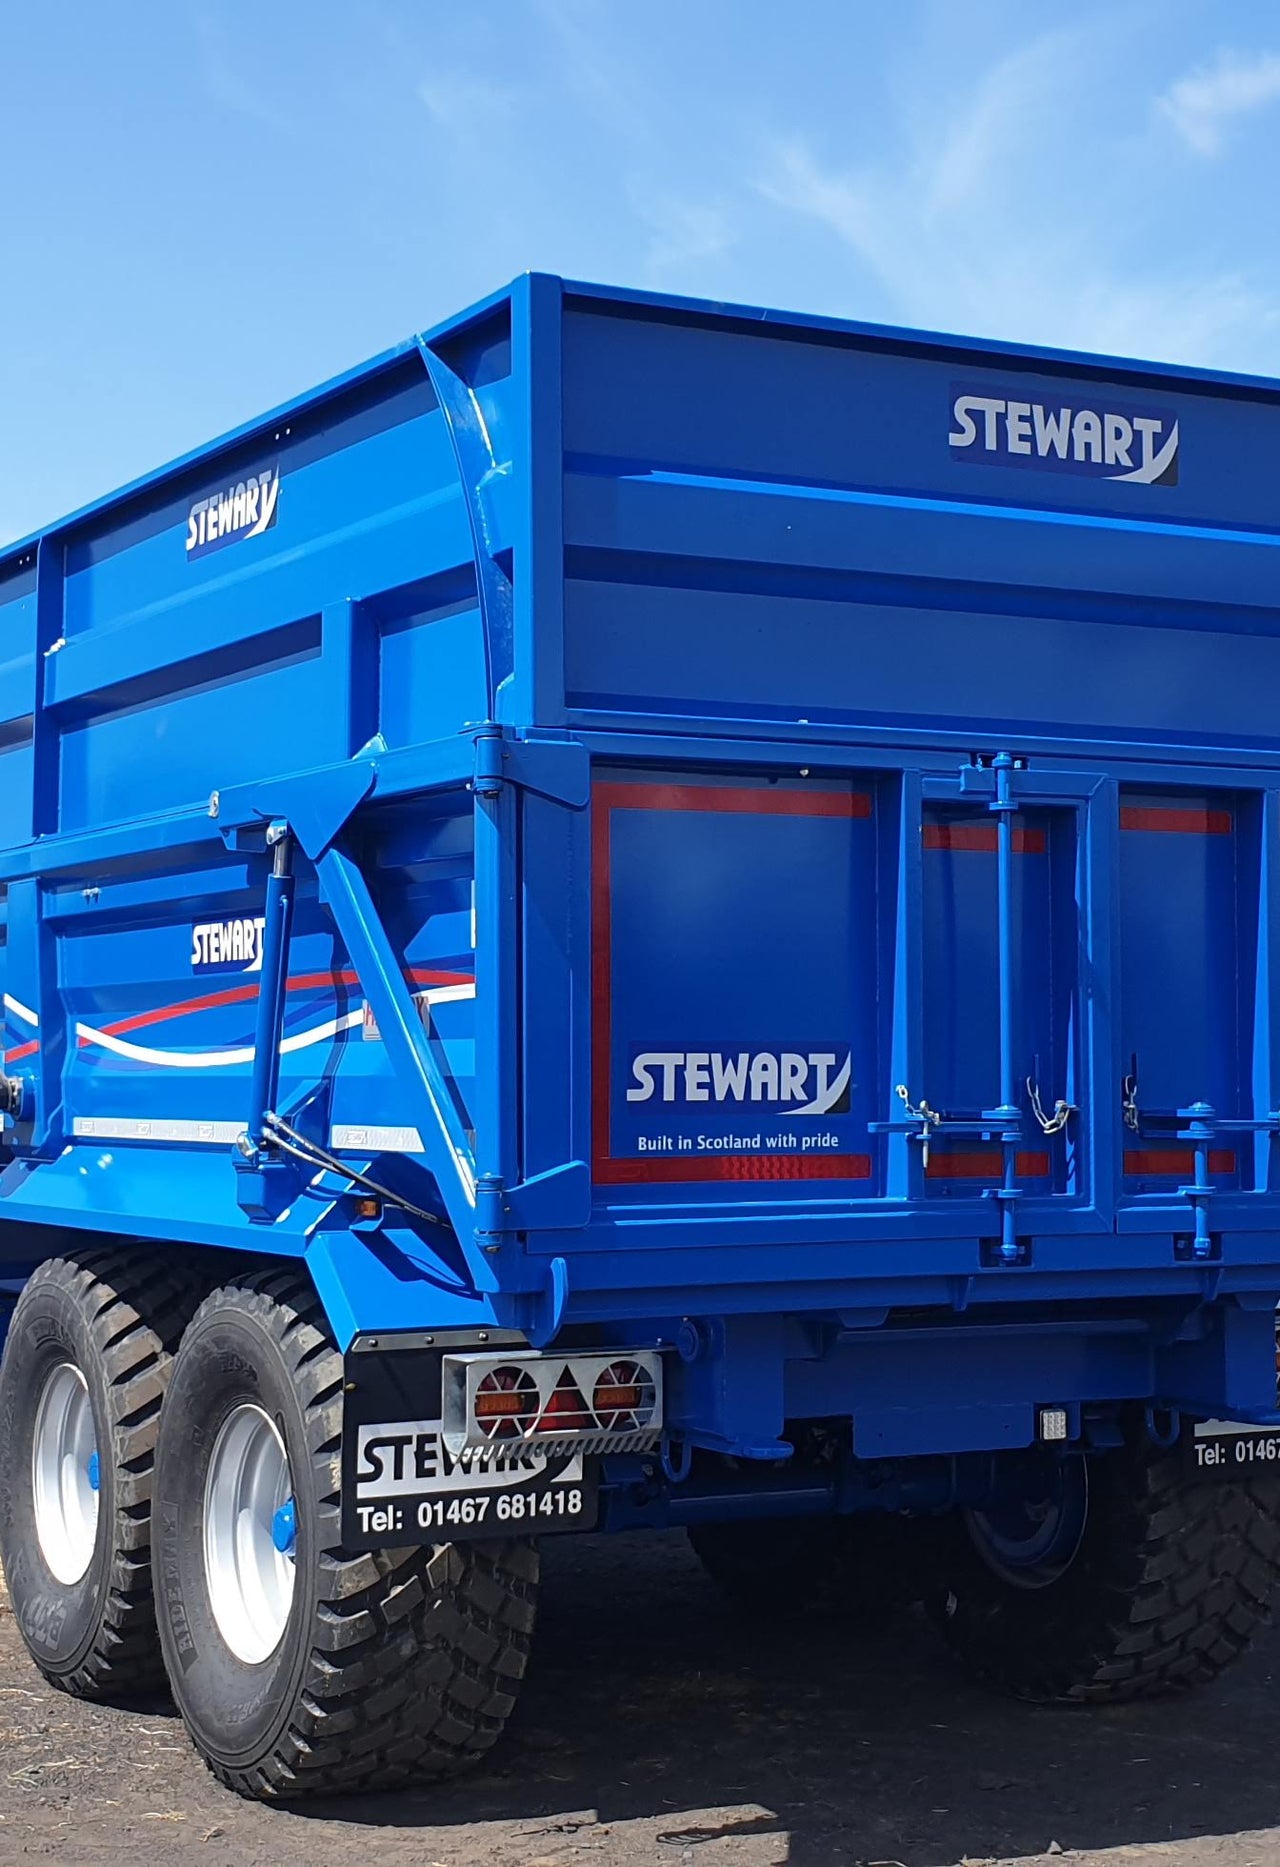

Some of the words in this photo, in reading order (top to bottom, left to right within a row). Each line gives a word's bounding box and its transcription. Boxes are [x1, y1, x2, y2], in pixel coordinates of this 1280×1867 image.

[949, 395, 1179, 484] STEWART
[185, 463, 279, 551] STEWART
[191, 917, 266, 972] STEWART
[626, 1050, 852, 1114] STEWART
[637, 1135, 673, 1151] Built
[678, 1135, 693, 1150] in
[697, 1133, 761, 1150] Scotland
[766, 1133, 797, 1149] with
[802, 1132, 839, 1151] pride
[1194, 1442, 1226, 1466] Tel:
[357, 1504, 404, 1533] Tel:
[417, 1496, 491, 1528] 01467
[496, 1489, 582, 1520] 681418
